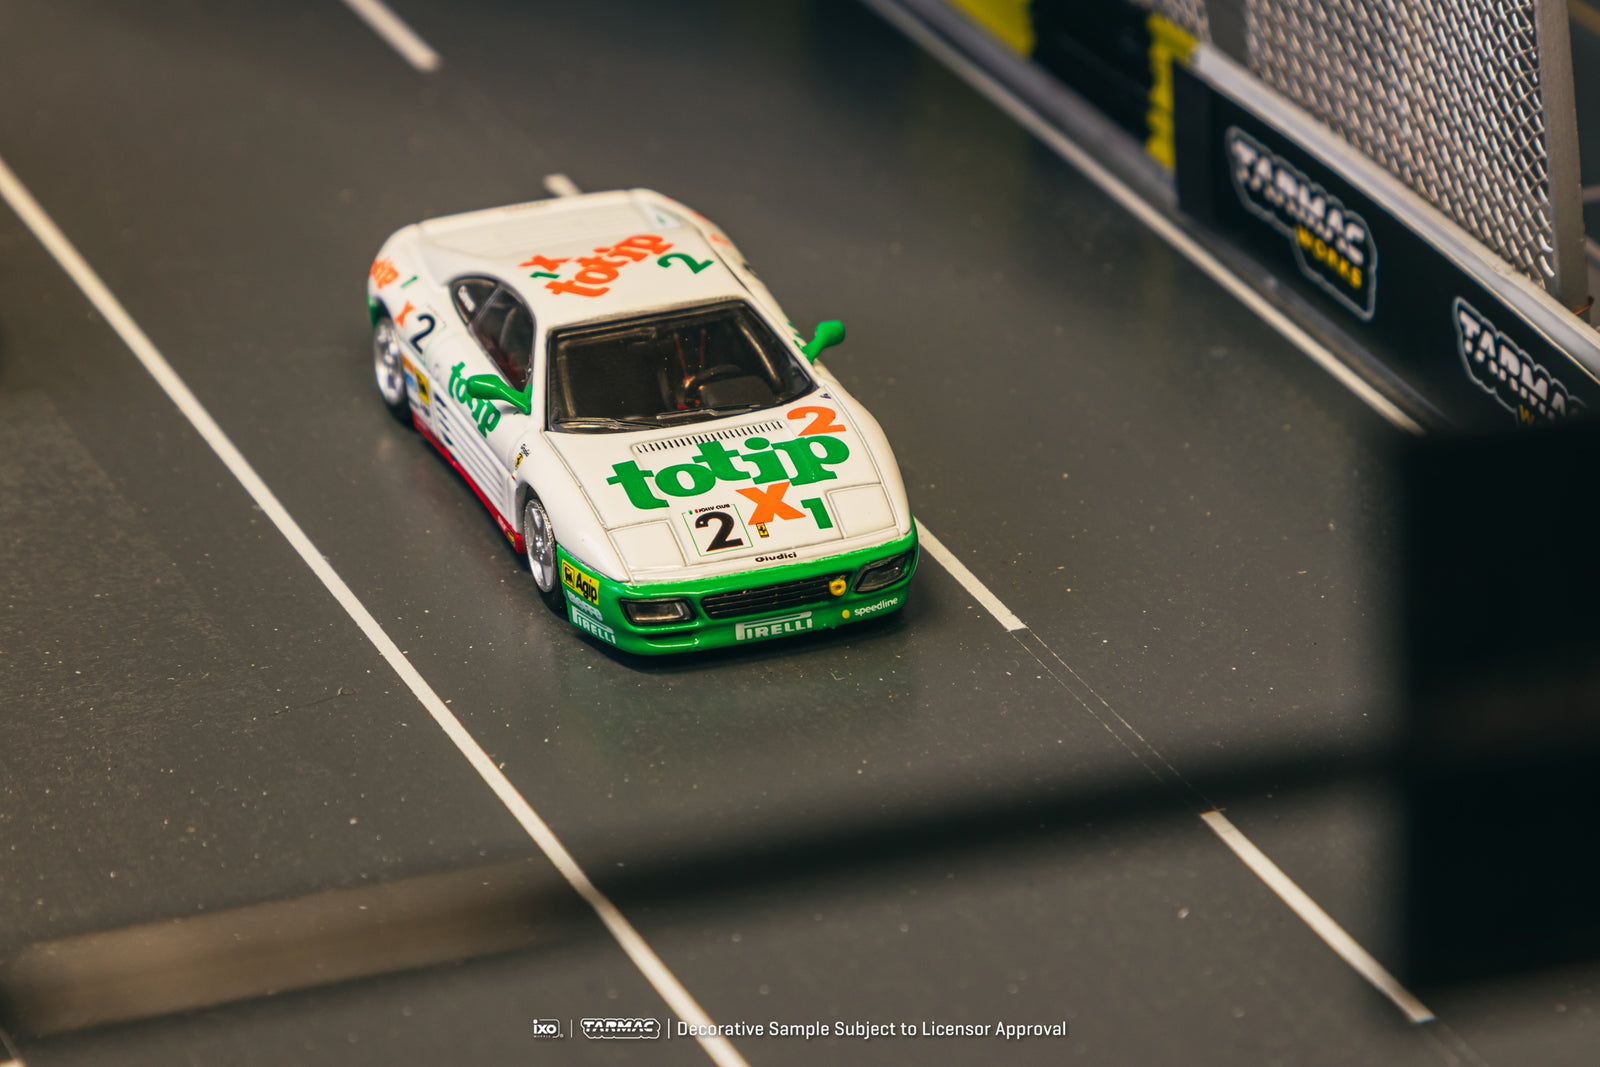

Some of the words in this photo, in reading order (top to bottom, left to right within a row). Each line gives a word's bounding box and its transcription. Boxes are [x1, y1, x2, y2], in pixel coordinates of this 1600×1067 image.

[1231, 139, 1365, 265] TARMAC
[544, 234, 674, 297] totip
[657, 253, 714, 274] 2
[1295, 224, 1363, 289] WORKS
[529, 271, 561, 279] 1
[410, 314, 435, 354] 2
[1459, 310, 1571, 420] TARMA
[787, 406, 846, 436] 2
[606, 435, 850, 510] totip
[695, 511, 744, 552] 2
[800, 497, 833, 530] 1
[755, 552, 797, 563] Giudici
[576, 573, 597, 602] Agip
[571, 605, 616, 644] PIRELLI
[854, 597, 898, 616] speedline
[735, 611, 812, 640] PIRELLI
